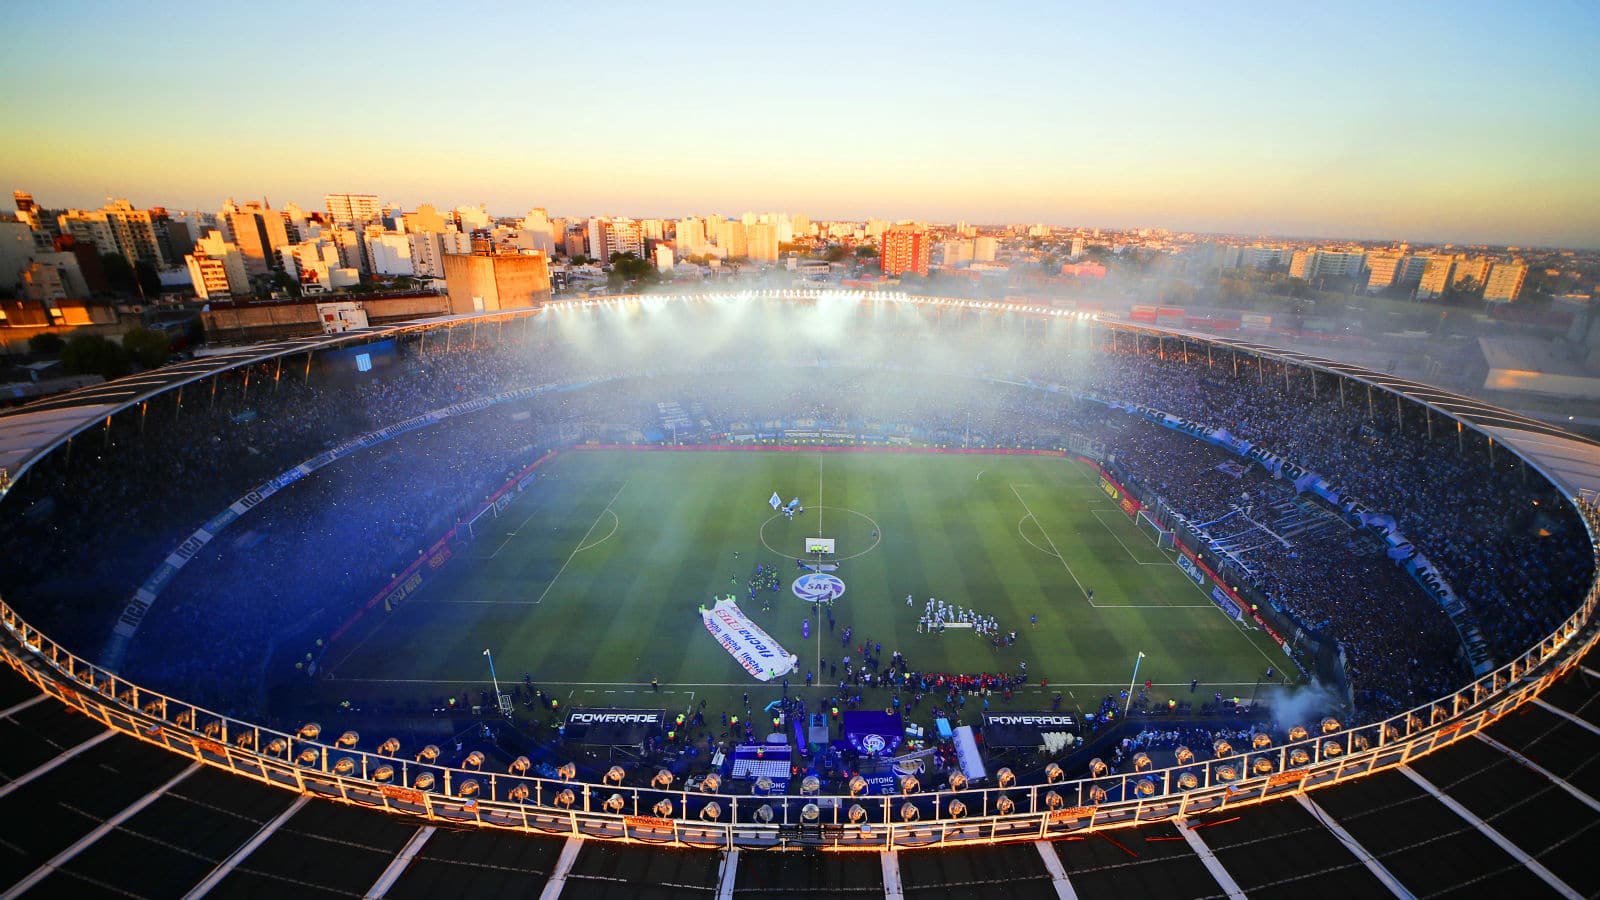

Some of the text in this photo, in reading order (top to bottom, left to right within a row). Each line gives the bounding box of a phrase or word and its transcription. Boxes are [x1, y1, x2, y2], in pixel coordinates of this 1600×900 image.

[175, 536, 204, 559] RCA
[807, 583, 829, 591] SAF
[120, 598, 149, 628] RCA
[738, 628, 774, 658] flecha
[570, 713, 657, 723] POWERADE
[988, 716, 1073, 725] POWERADE
[866, 776, 894, 785] YUTONG
